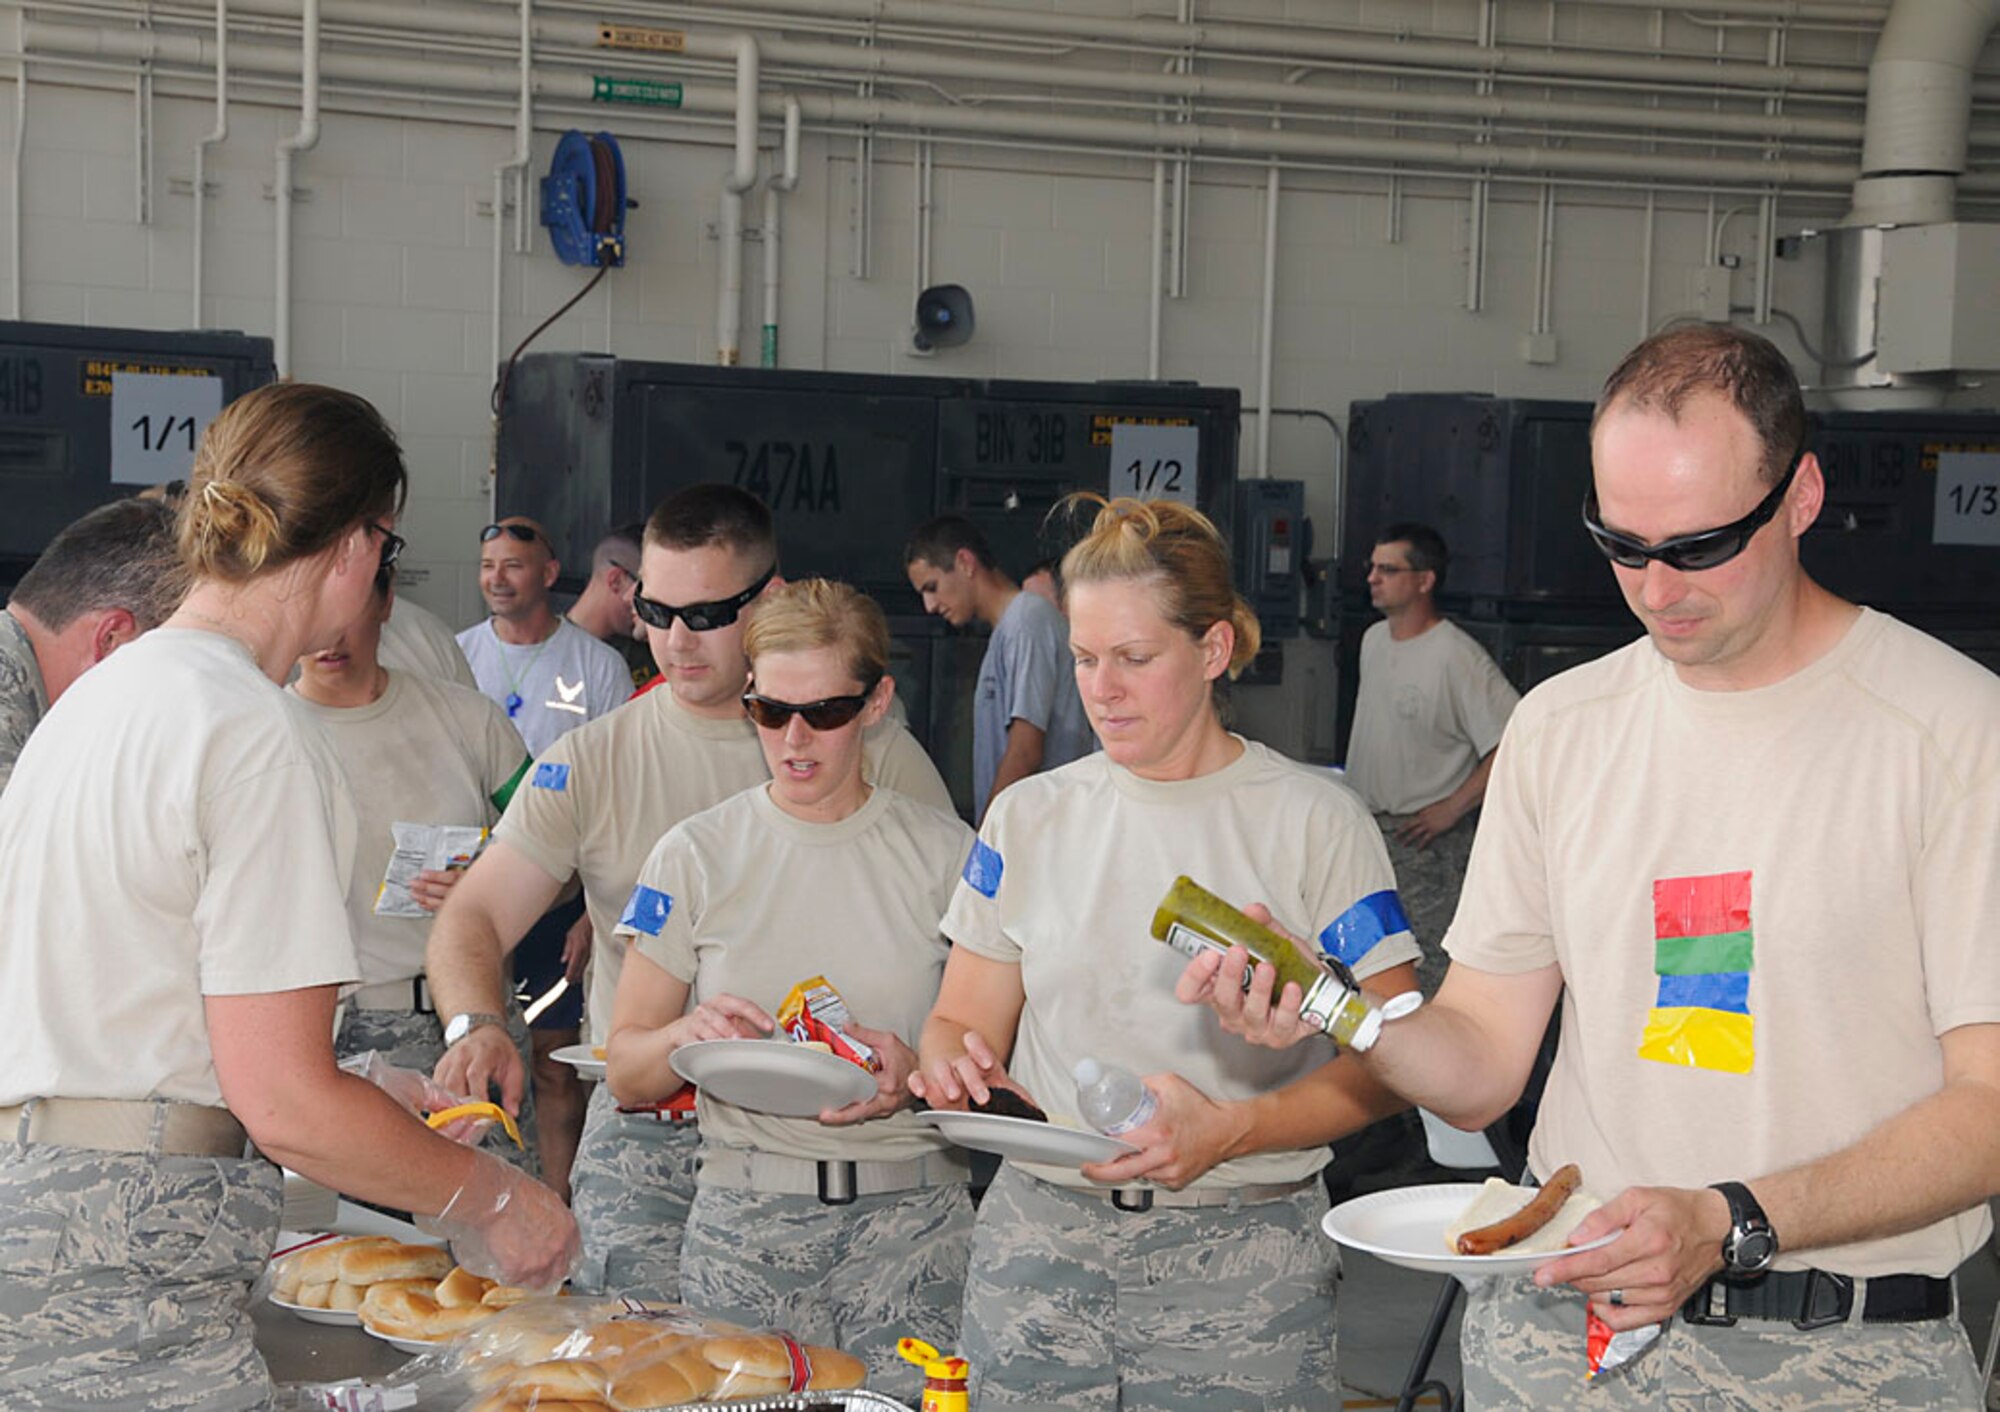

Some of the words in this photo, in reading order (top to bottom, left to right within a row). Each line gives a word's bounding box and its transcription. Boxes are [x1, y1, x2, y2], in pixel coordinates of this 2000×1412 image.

[132, 415, 196, 451] 1/1
[976, 411, 1016, 465] BIN
[1126, 459, 1183, 492] 1/2
[1949, 484, 1998, 516] 1/3
